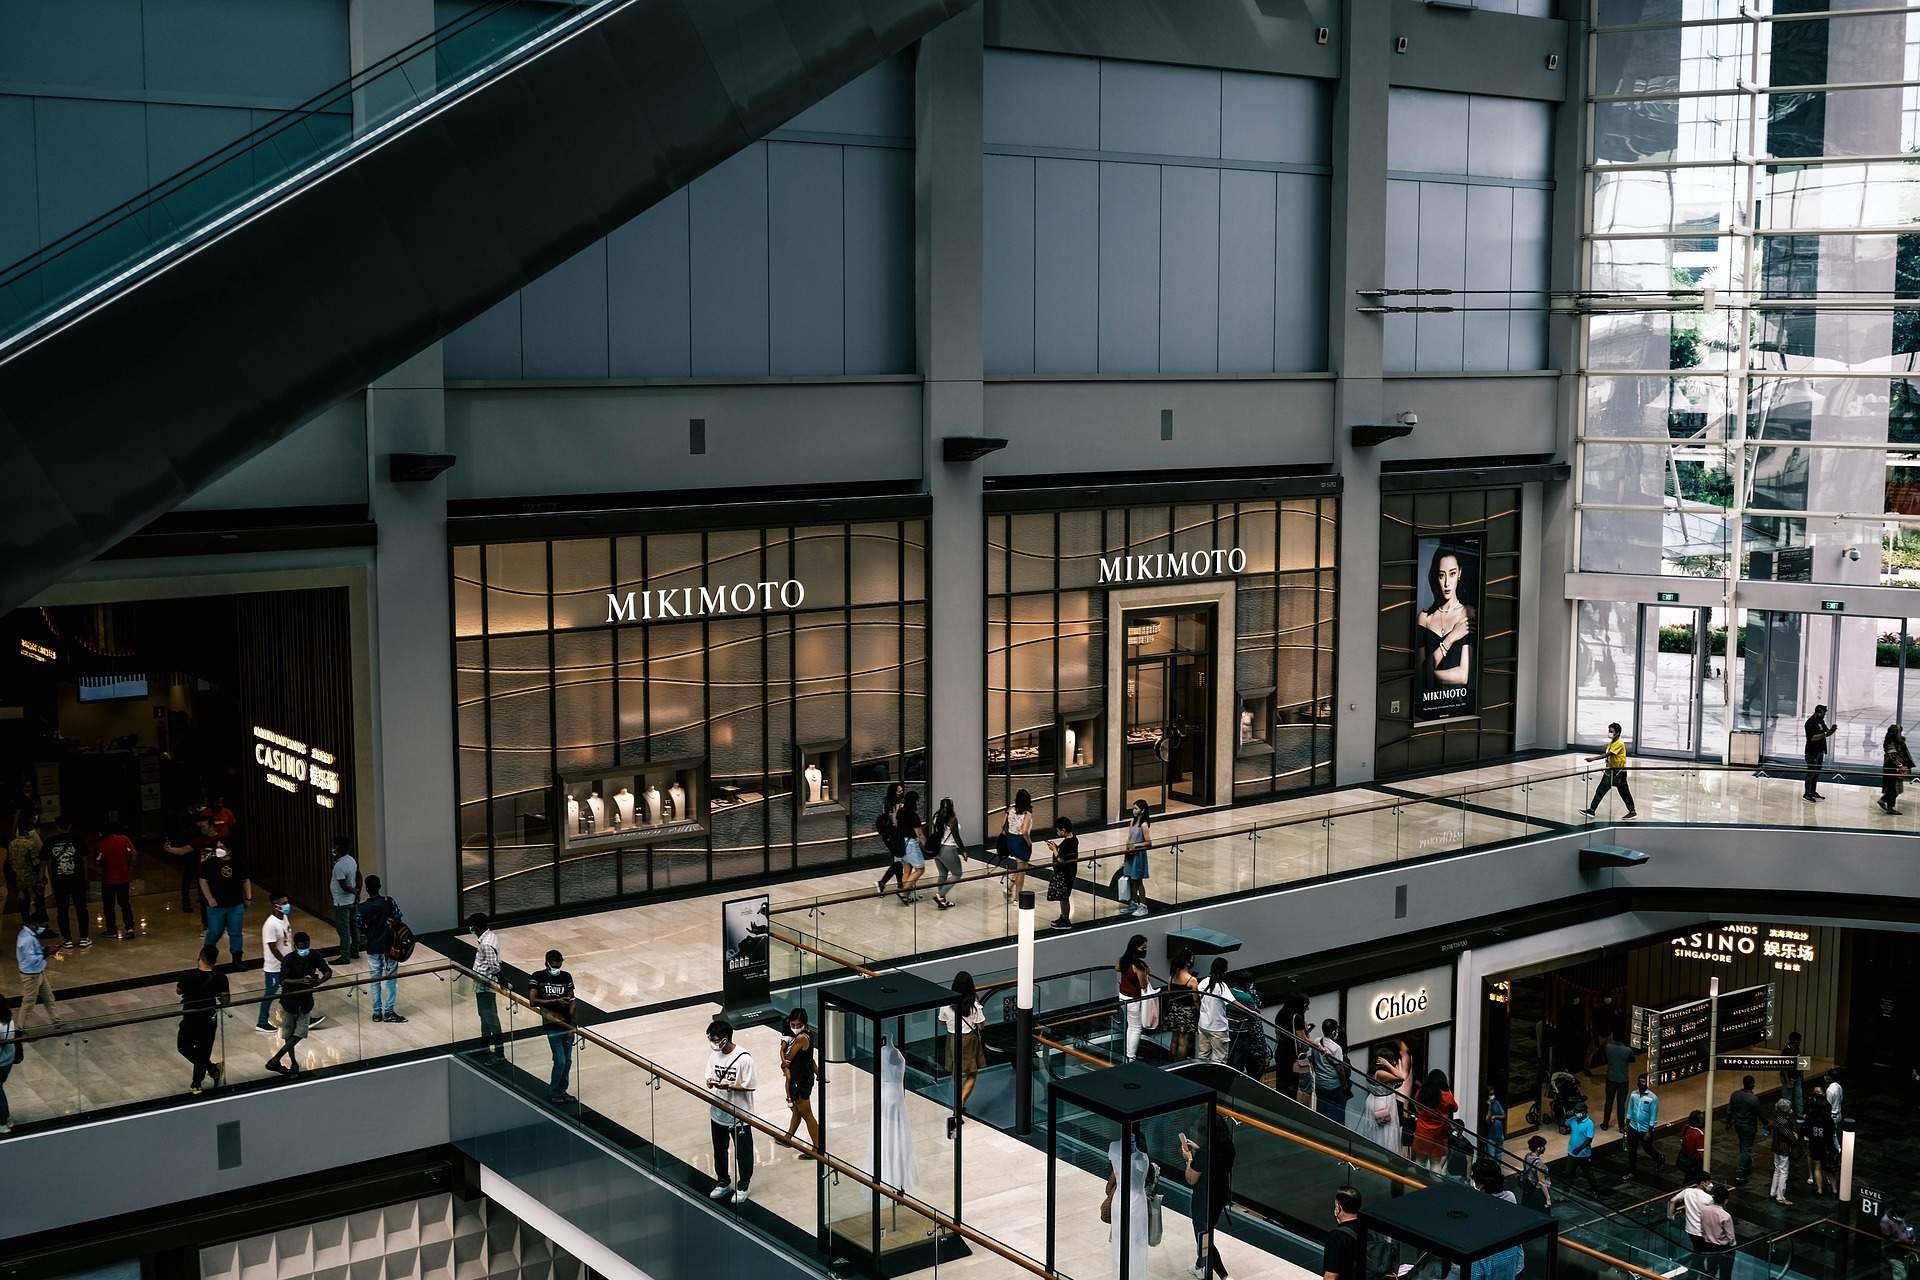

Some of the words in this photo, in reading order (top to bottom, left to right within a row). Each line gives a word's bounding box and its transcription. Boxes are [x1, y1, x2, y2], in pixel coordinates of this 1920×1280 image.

[1098, 548, 1247, 583] MIKIMOTO
[606, 579, 805, 623] MIKIMOTO
[1423, 688, 1467, 701] MIKIMOTO
[255, 743, 307, 781] CASINO
[1674, 948, 1732, 963] SINGAPORE
[1763, 940, 1815, 962] 娱乐场
[1375, 989, 1428, 1021] Chloé
[1861, 1188, 1882, 1200] LEVEL
[1862, 1198, 1879, 1216] B1
